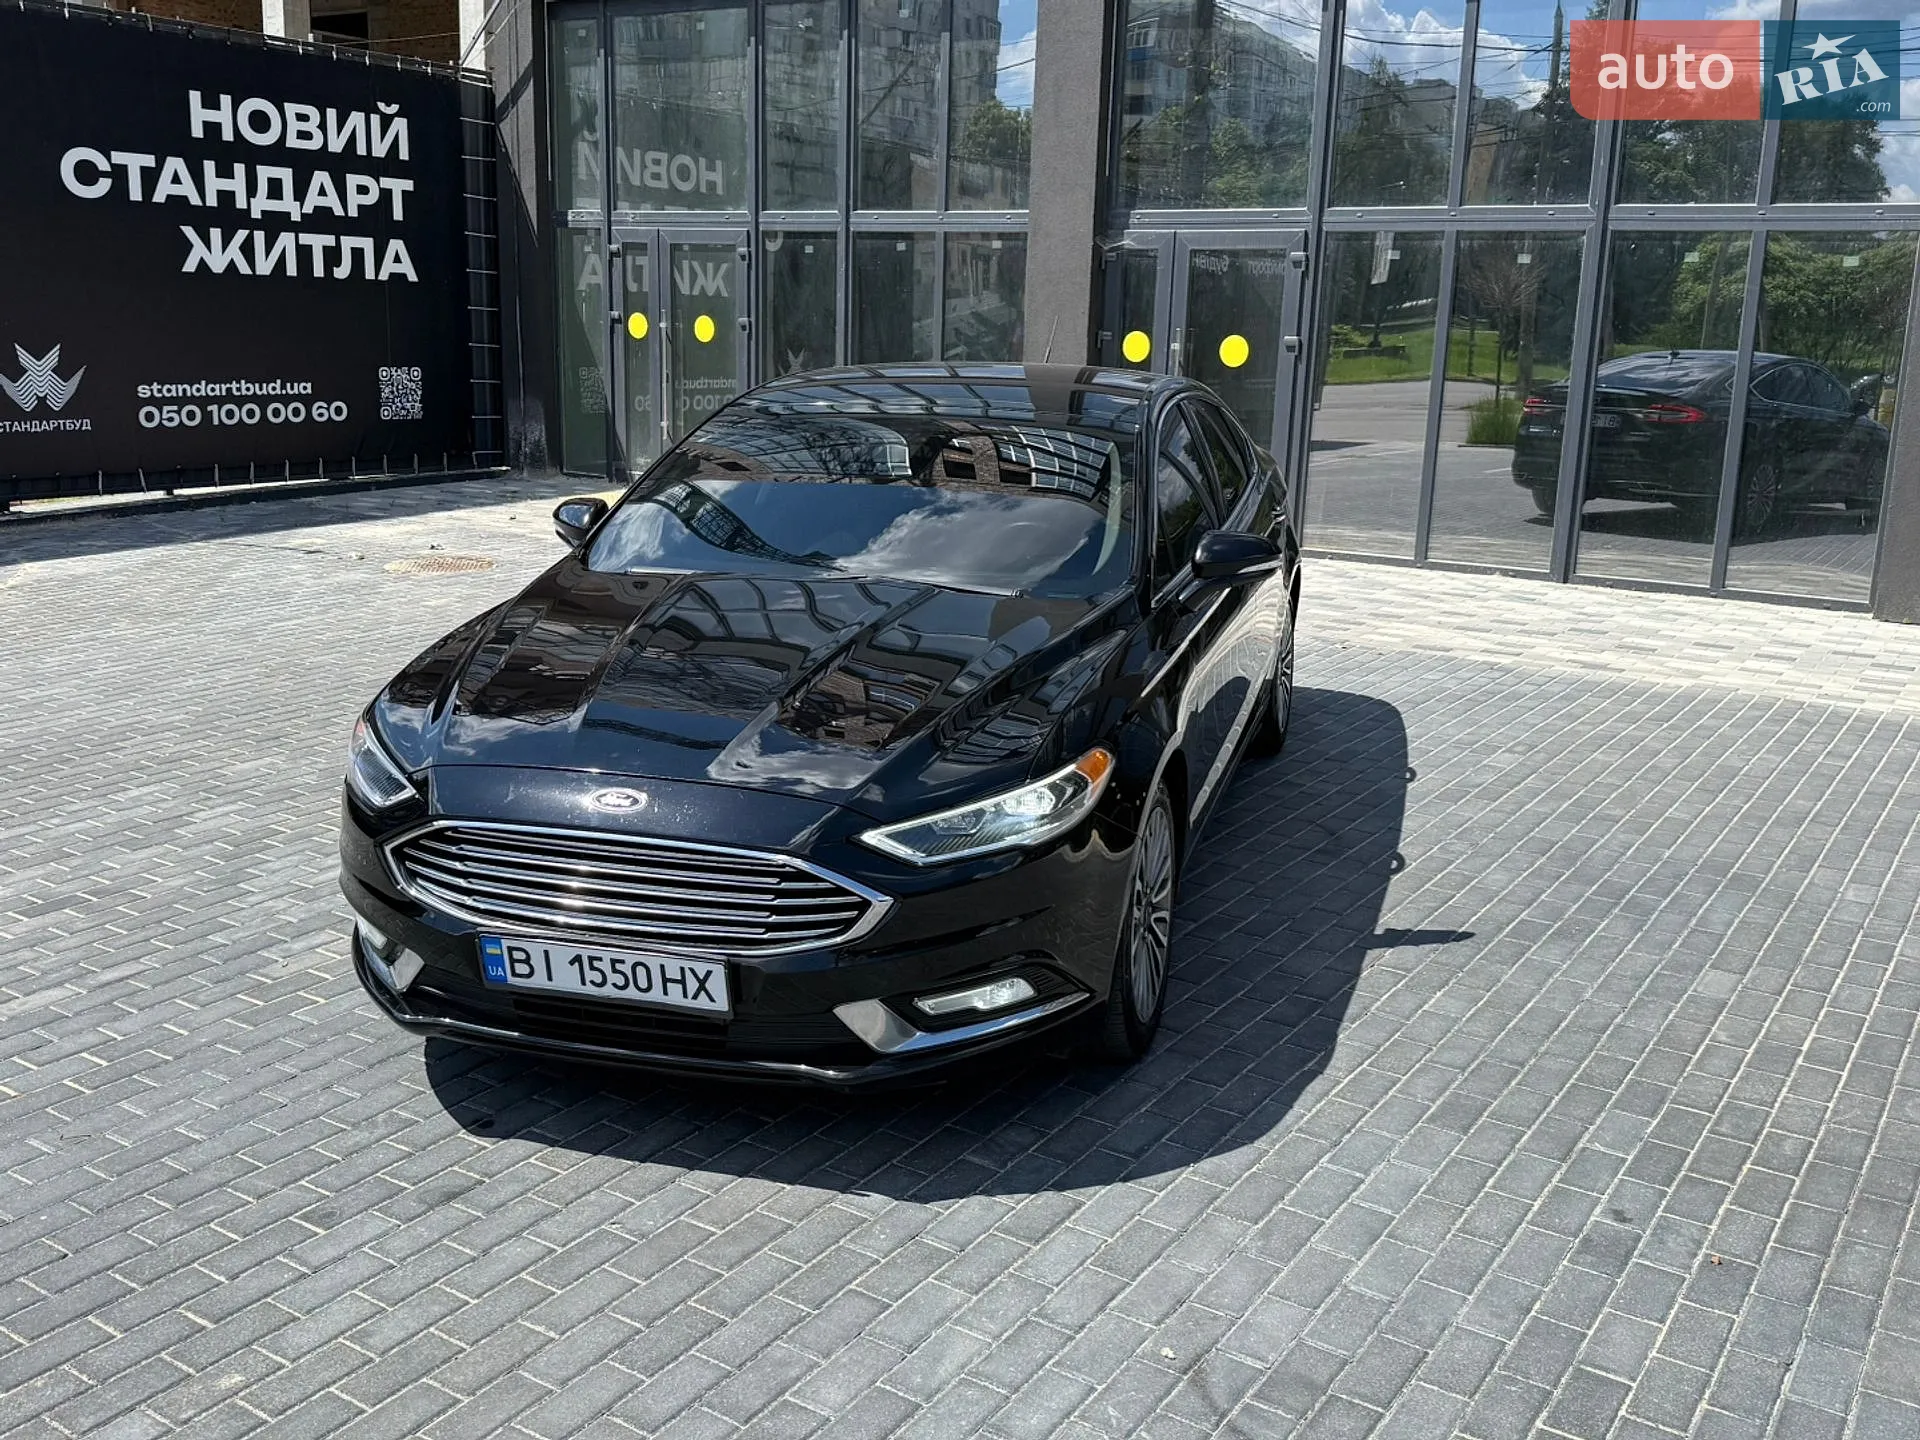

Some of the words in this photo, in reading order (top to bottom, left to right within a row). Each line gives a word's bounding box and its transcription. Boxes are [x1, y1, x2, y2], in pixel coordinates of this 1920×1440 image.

[188, 89, 410, 161] НОВИЙ
[59, 146, 415, 222] СТАНДАРТ
[179, 225, 419, 283] ЖИТЛА
[137, 379, 313, 398] standartbud.ua
[138, 404, 202, 428] 050
[207, 403, 261, 426] 100
[266, 402, 306, 424] 00
[311, 401, 348, 422] 60
[488, 965, 505, 977] UA
[506, 945, 553, 982] BI
[568, 953, 654, 994] 1550
[660, 964, 717, 1004] HX
